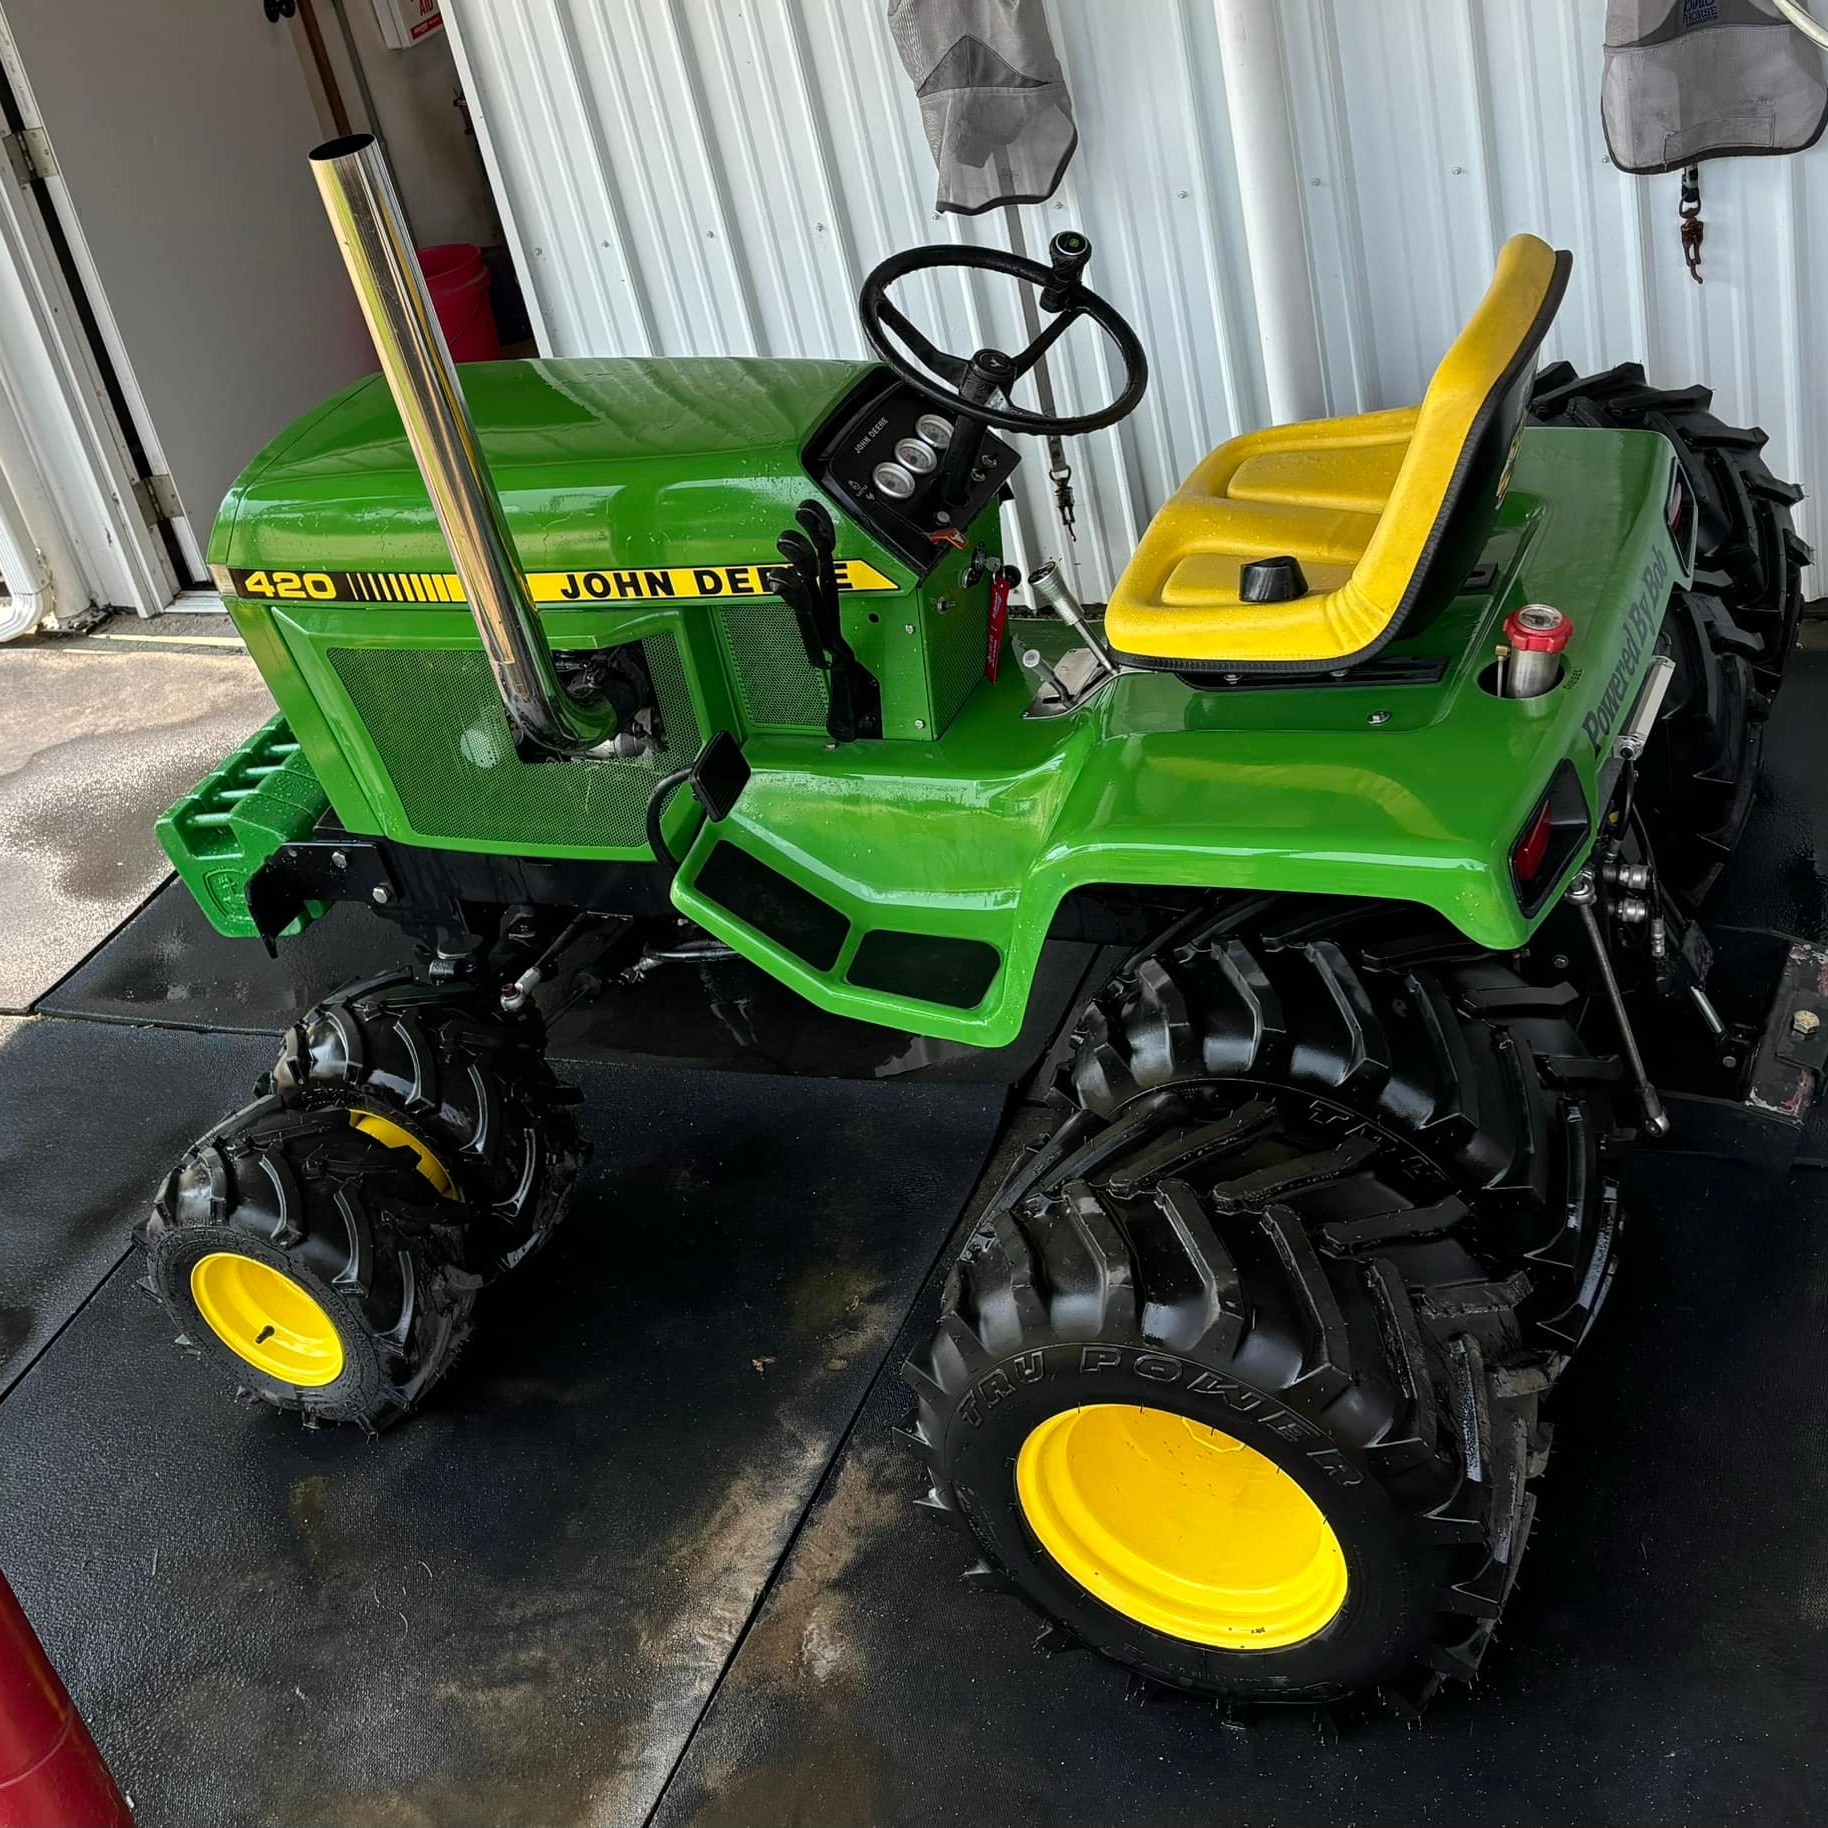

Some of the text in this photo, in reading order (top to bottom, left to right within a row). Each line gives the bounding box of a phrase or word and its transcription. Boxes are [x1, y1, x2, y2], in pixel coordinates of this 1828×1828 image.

[854, 416, 889, 454] JOHN DEERE
[243, 571, 337, 599] 420
[560, 562, 853, 599] JOHN DEE
[1582, 544, 1667, 760] Powered By Bob
[960, 1346, 1367, 1487] TRU POWER
